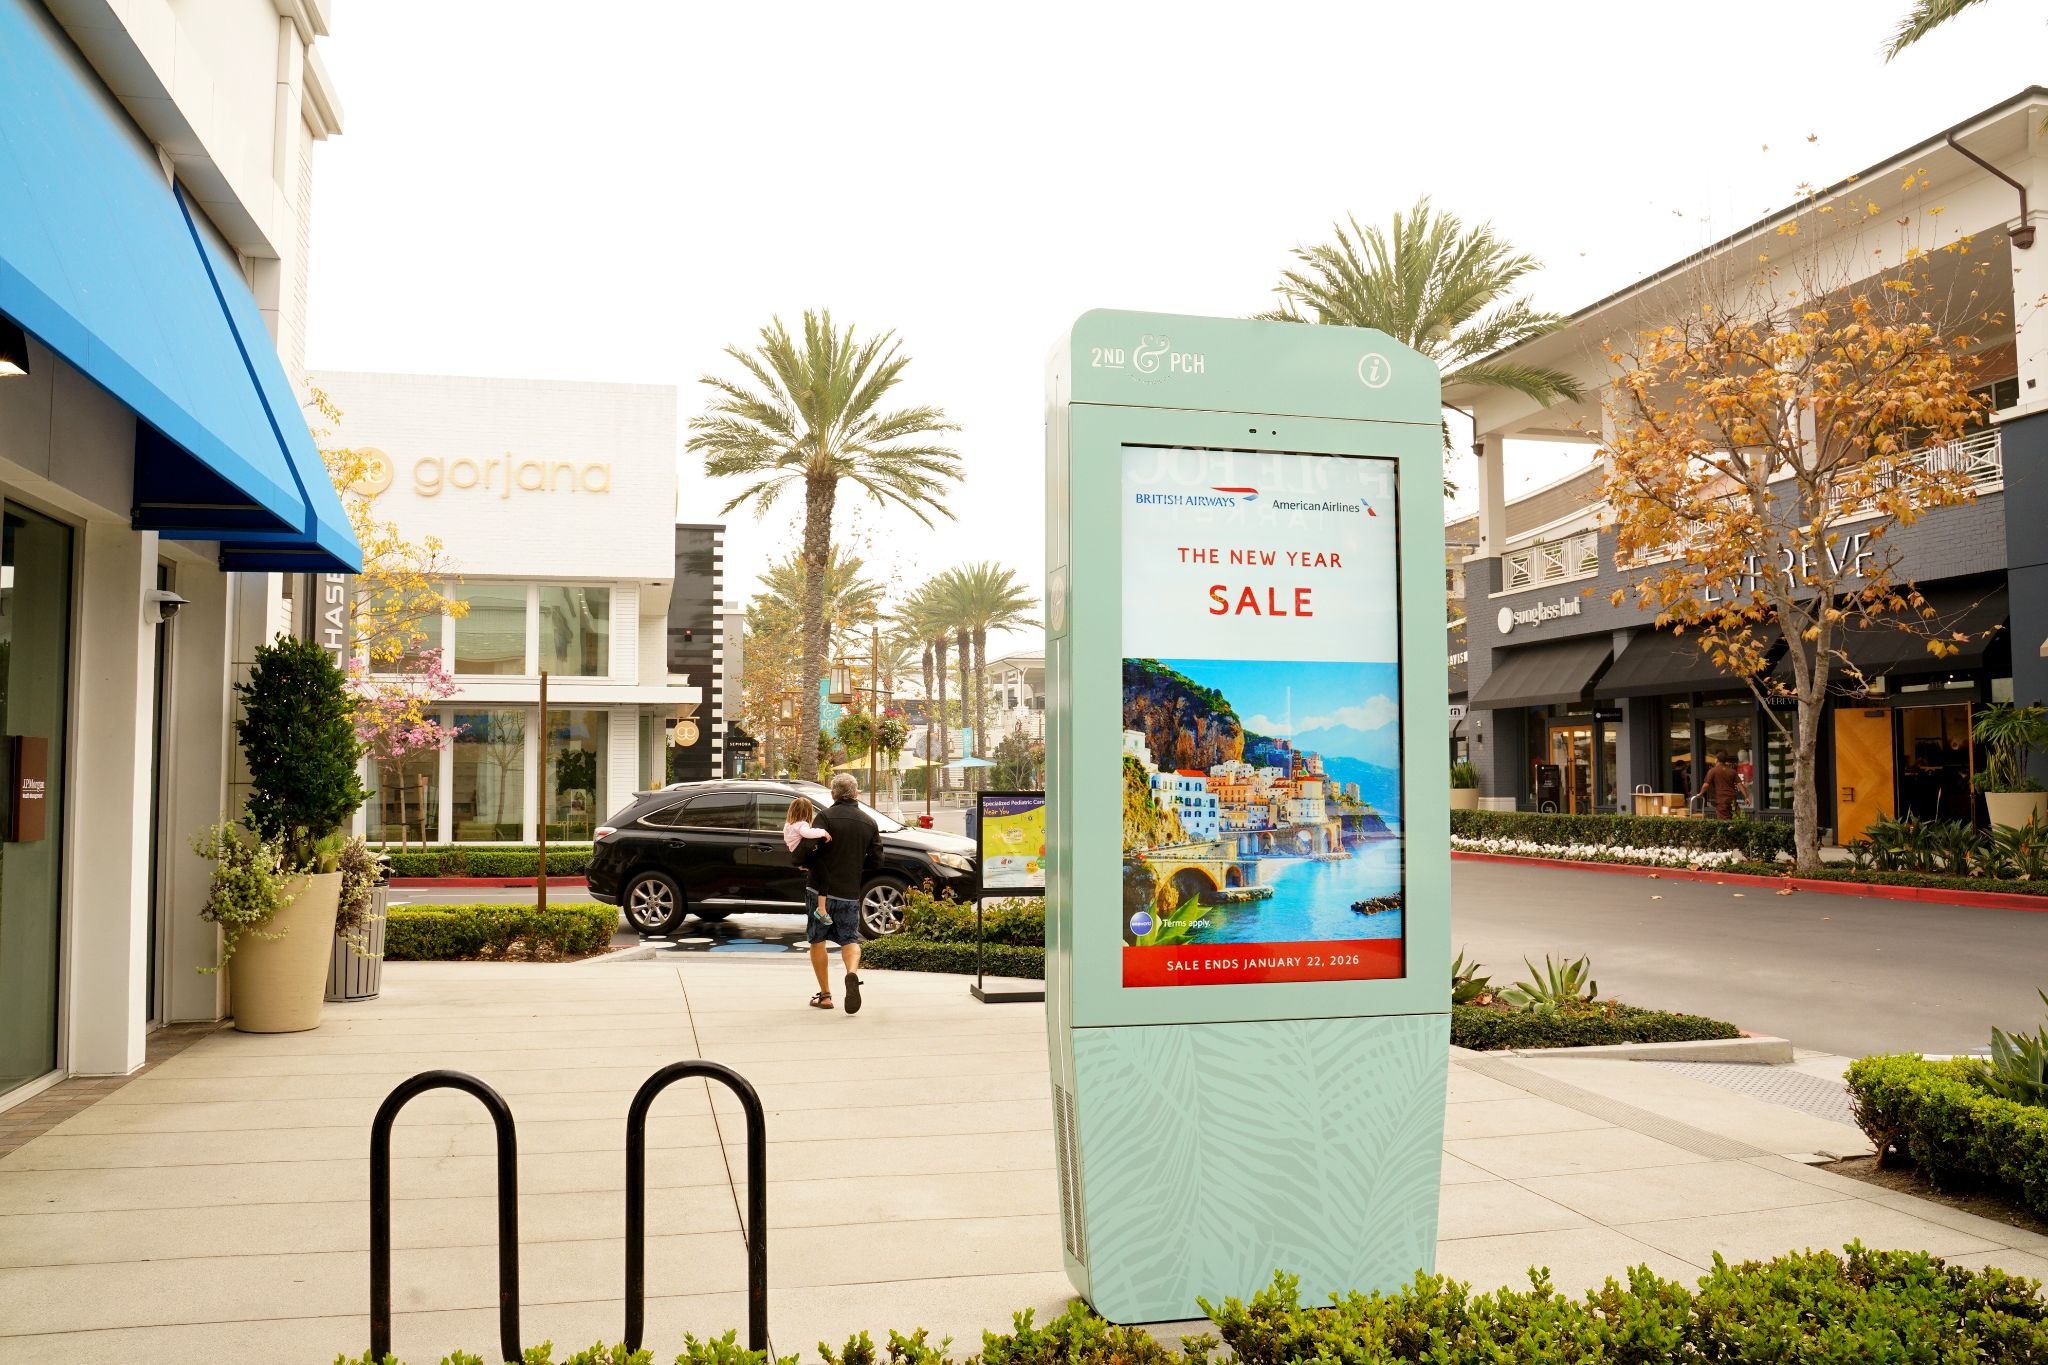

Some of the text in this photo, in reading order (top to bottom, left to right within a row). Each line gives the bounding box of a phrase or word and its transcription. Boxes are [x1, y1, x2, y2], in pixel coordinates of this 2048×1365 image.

[1091, 334, 1205, 374] 2ND & PCH
[412, 451, 613, 500] gorjana
[1135, 493, 1236, 507] BRITISH AIRWAYS
[1272, 499, 1360, 513] American Airlines
[1177, 547, 1342, 568] THE NEW YEAR
[1208, 584, 1313, 617] SALE
[1513, 596, 1582, 627] sunglass hut
[983, 806, 1010, 816] Near You
[1162, 919, 1211, 929] Terms apply.
[1167, 955, 1359, 971] SALE ENDS JANUARY 22, 2026
